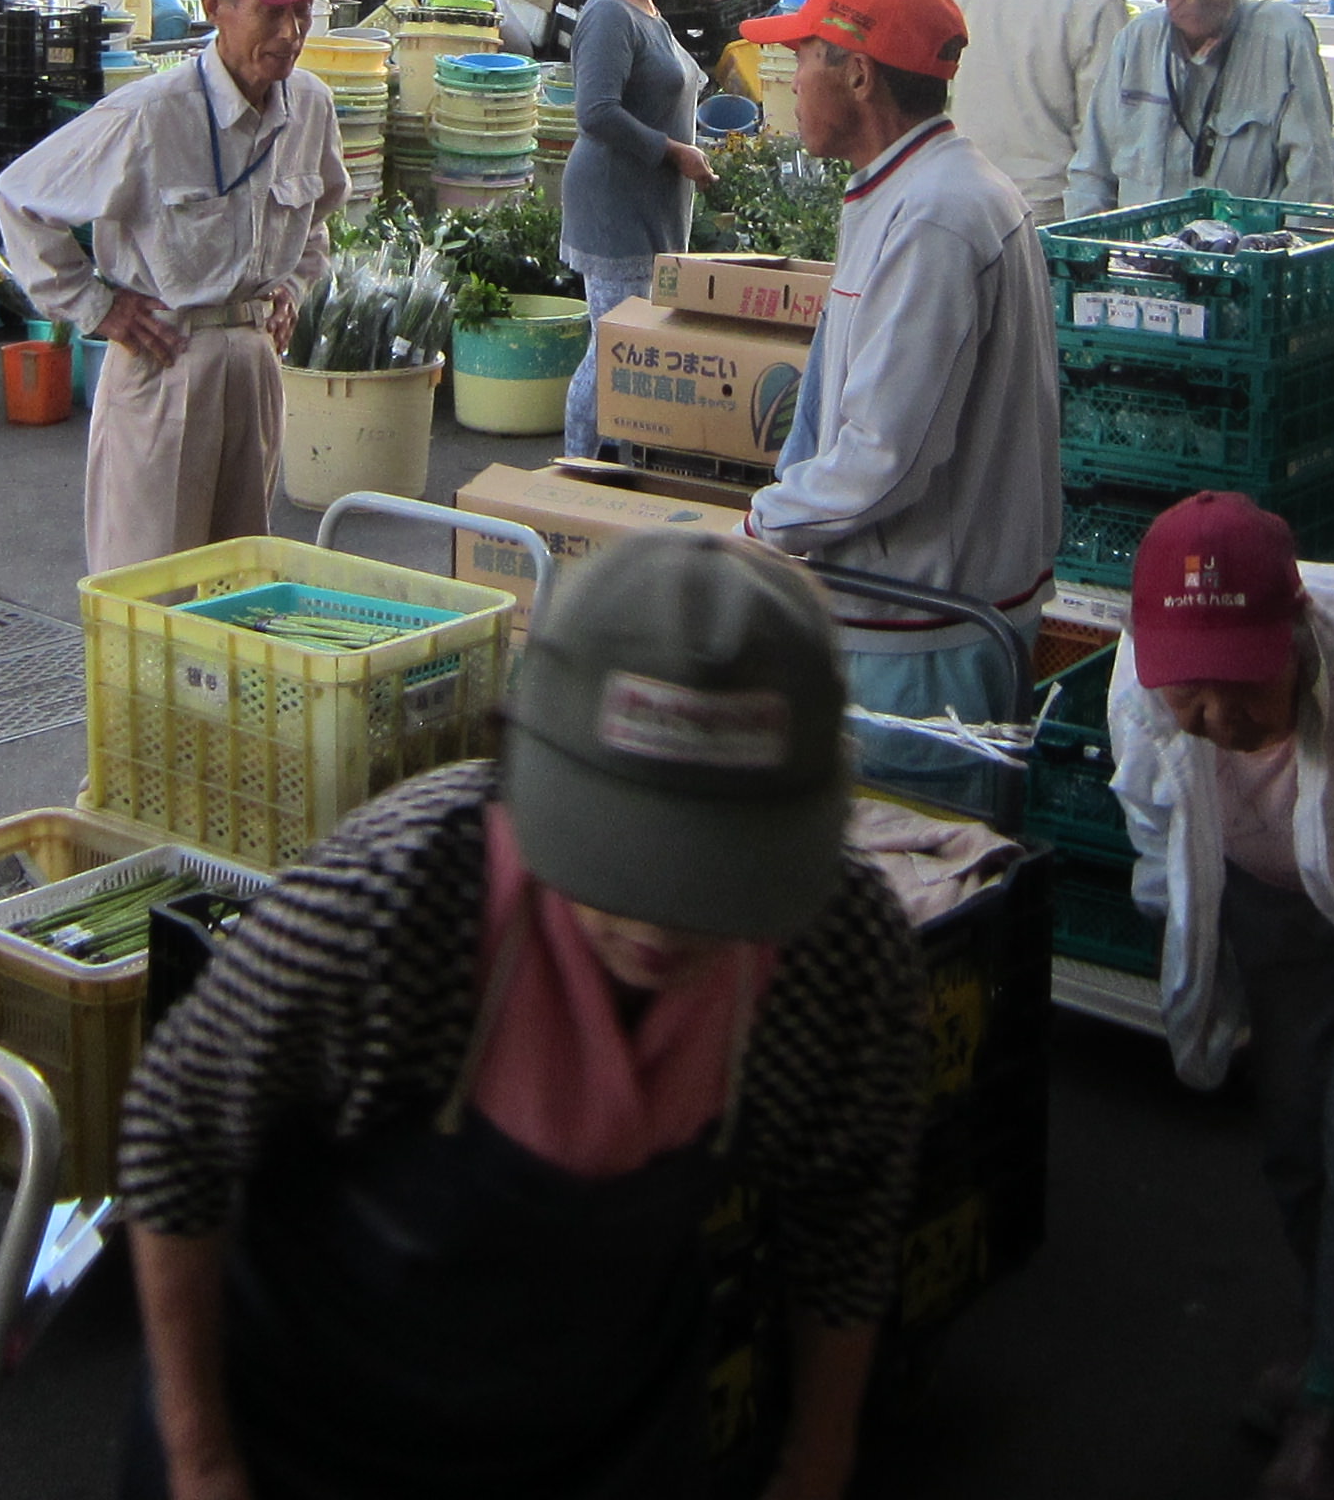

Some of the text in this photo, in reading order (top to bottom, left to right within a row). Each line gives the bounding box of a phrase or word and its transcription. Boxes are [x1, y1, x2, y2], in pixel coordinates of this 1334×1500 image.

[611, 341, 738, 379] ぐんま つまごい
